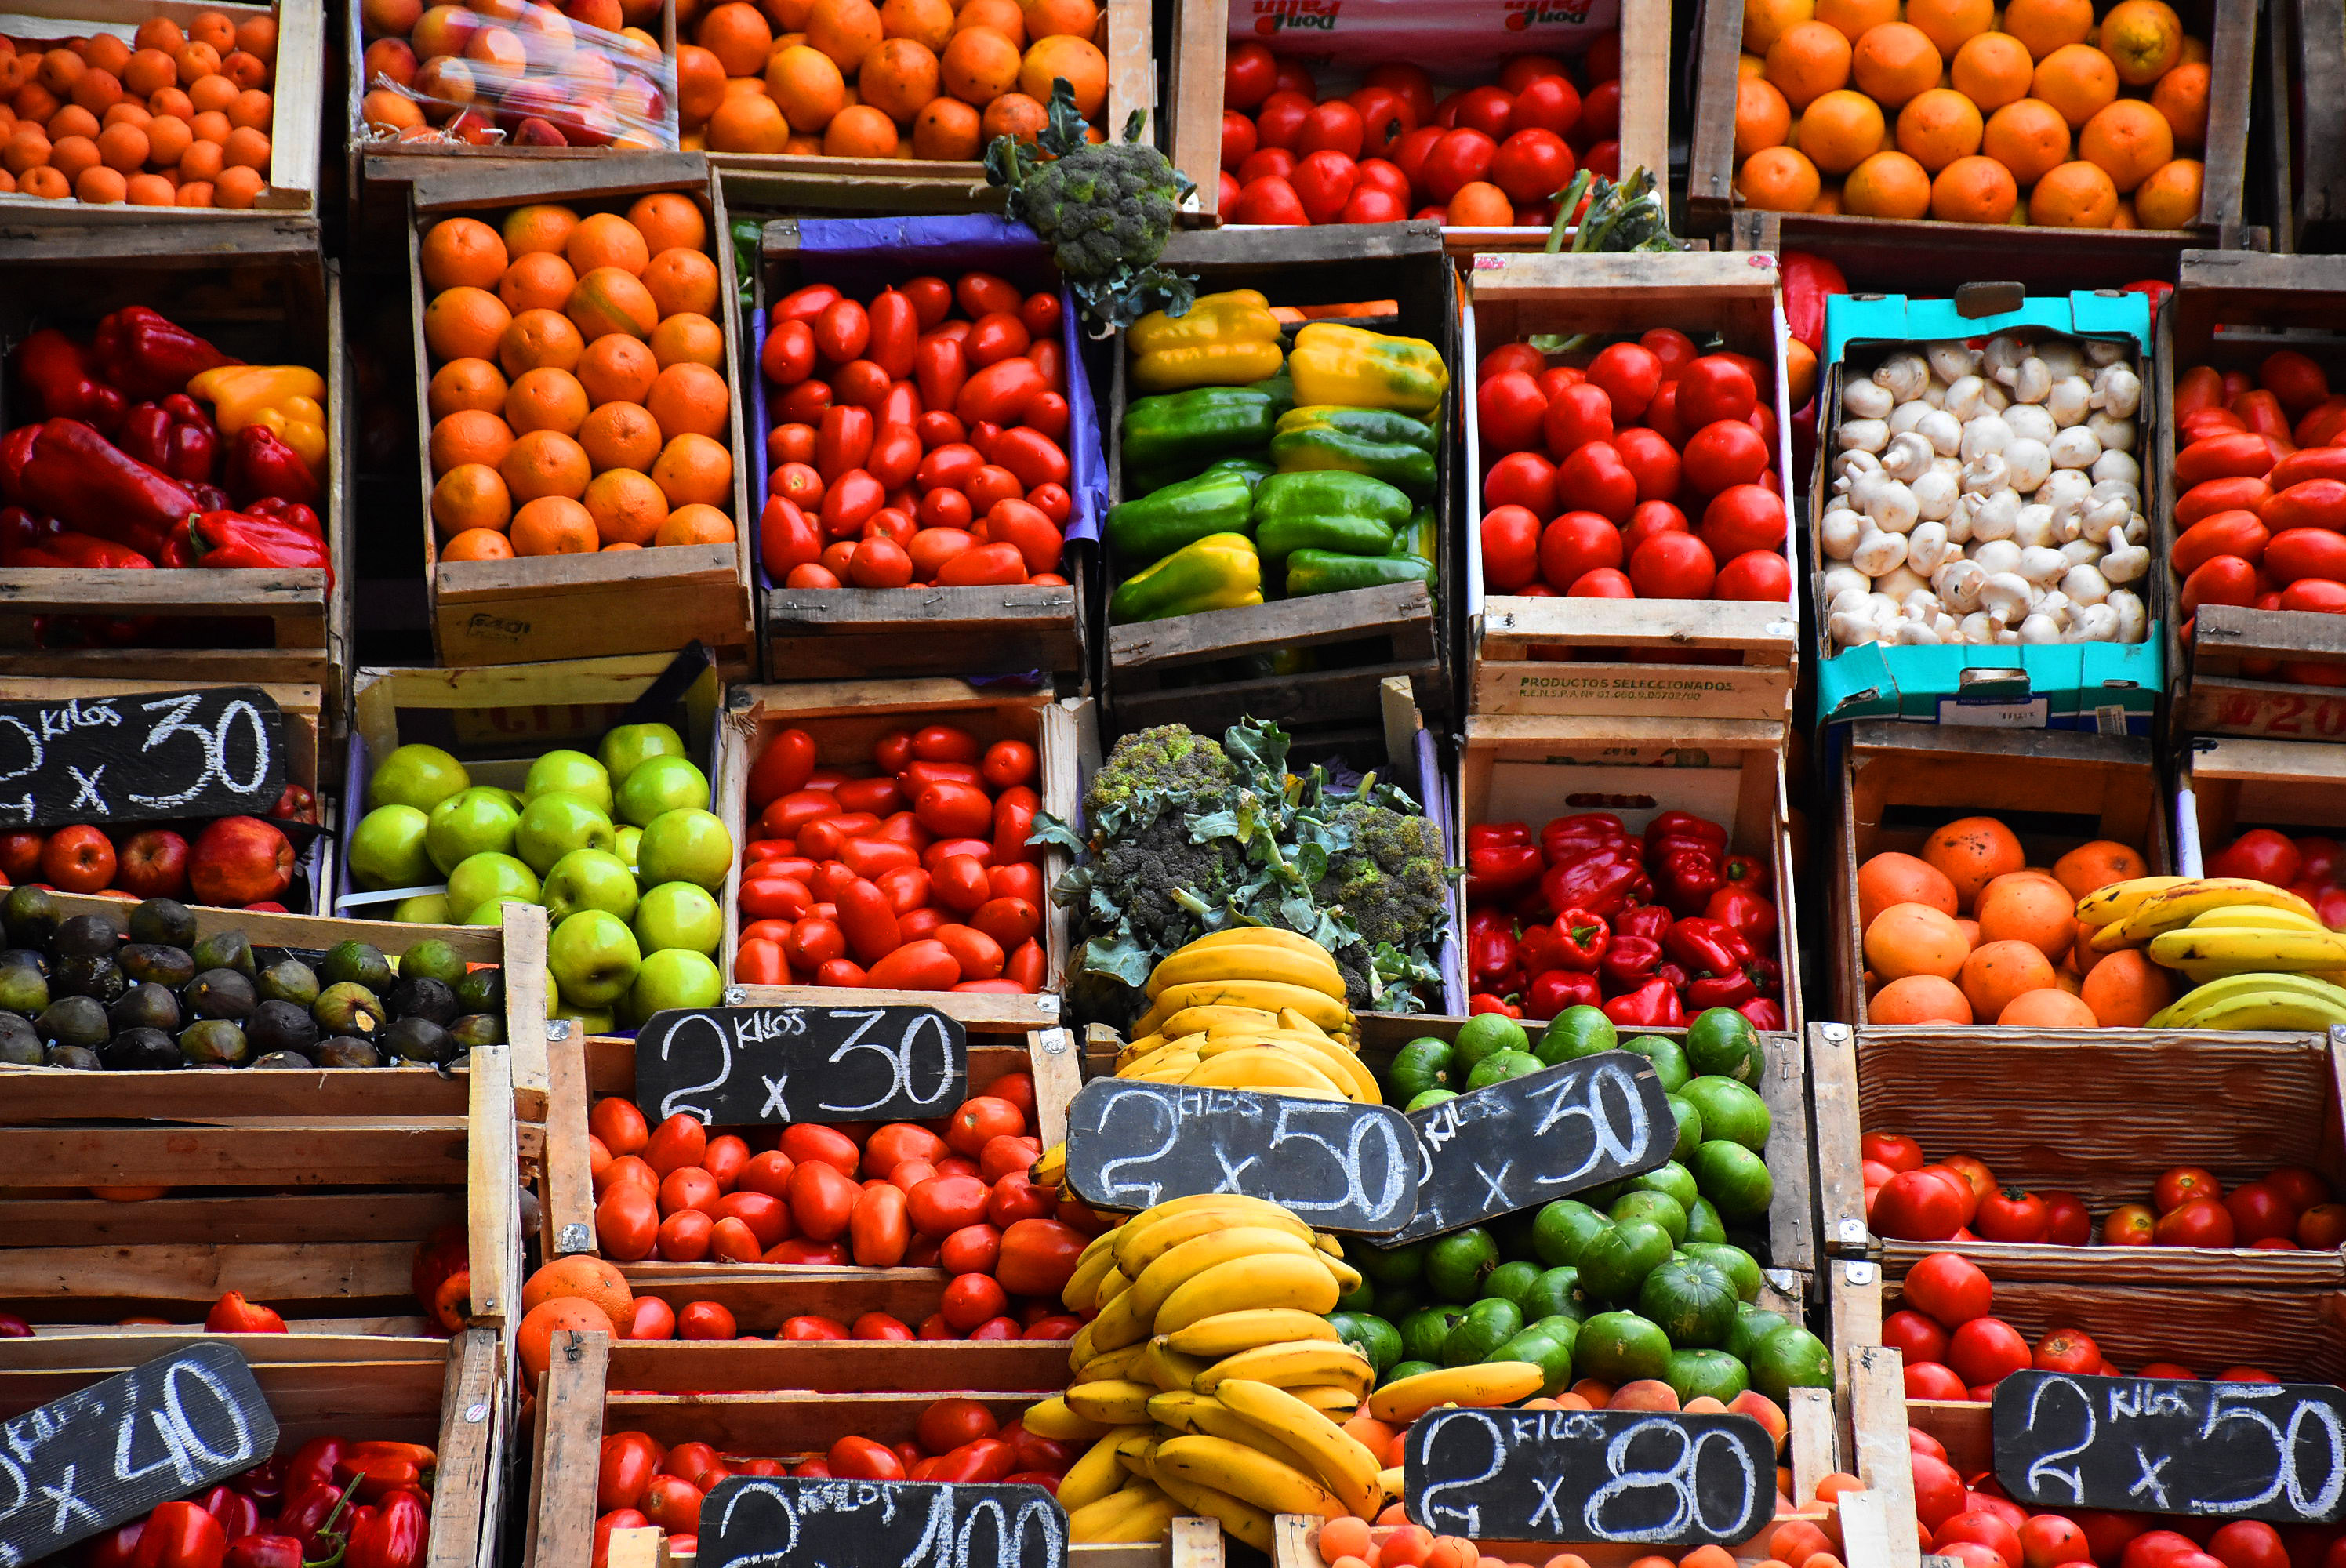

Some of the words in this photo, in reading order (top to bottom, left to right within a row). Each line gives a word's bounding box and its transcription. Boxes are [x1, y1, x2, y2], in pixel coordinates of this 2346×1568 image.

[1520, 677, 1609, 688] PRODUCTOS
[128, 693, 270, 809] 30
[660, 1014, 732, 1126] 2
[819, 1009, 954, 1112] 30
[1525, 1063, 1651, 1185] 30
[1098, 1089, 1178, 1208] 2
[1269, 1099, 1409, 1222] 50
[114, 1359, 253, 1487] 40
[1420, 1410, 1507, 1539] 2
[1584, 1417, 1756, 1543] 80
[2027, 1375, 2096, 1506] 2
[2190, 1384, 2346, 1519] 50
[719, 1481, 800, 1568] 2
